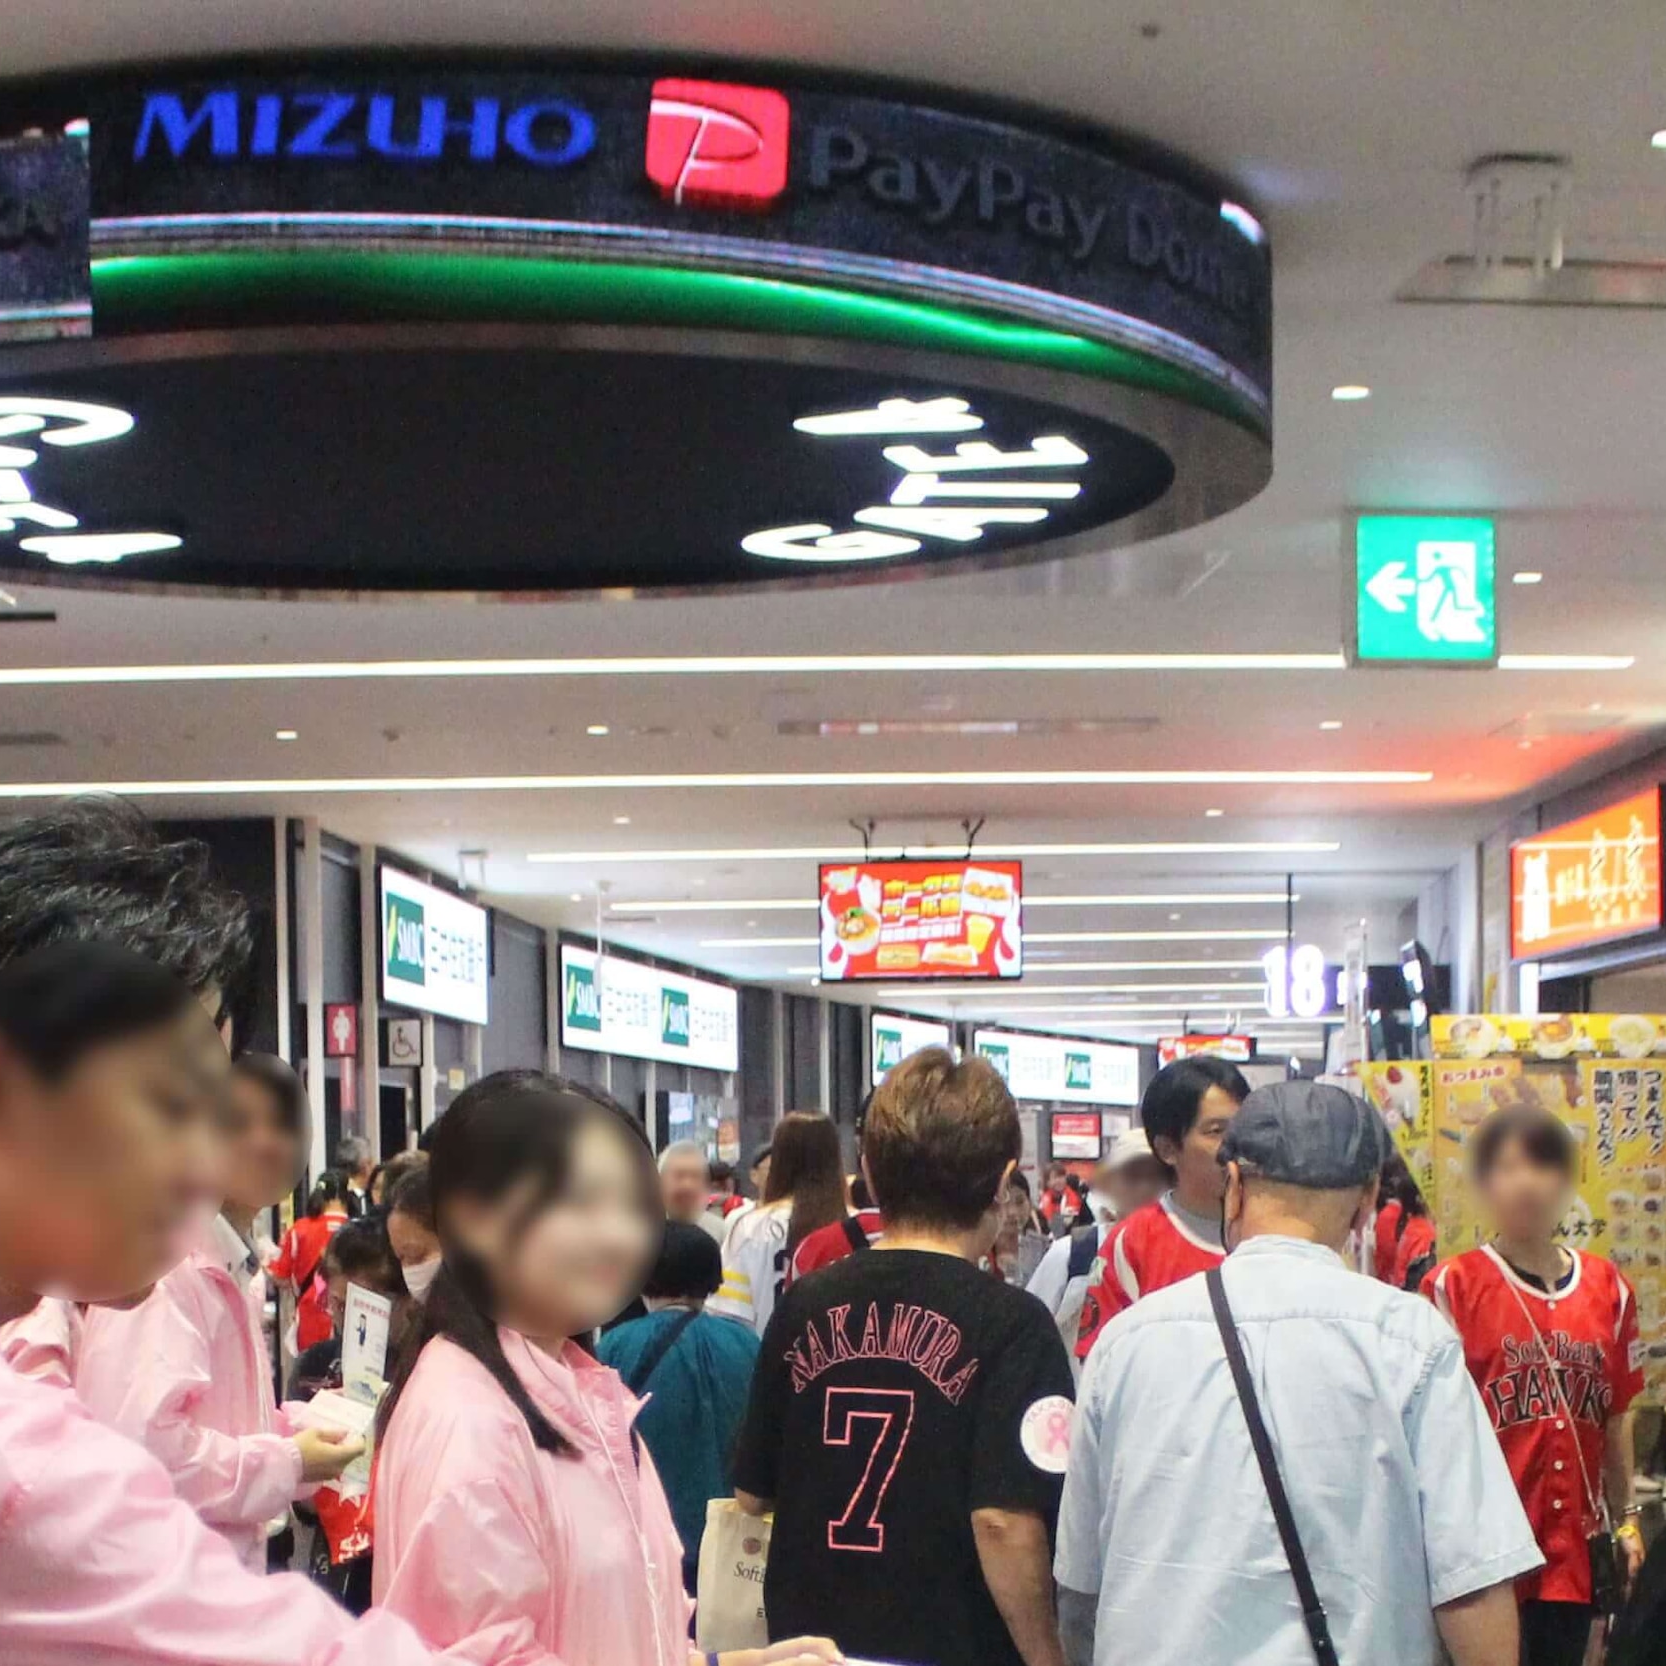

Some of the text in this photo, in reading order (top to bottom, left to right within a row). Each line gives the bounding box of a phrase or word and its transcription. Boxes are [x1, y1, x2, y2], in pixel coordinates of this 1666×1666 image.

[133, 91, 597, 166] MIZUHO
[810, 125, 1107, 260] PayPay
[741, 436, 1090, 563] GATE
[1262, 944, 1327, 1018] 18
[783, 1301, 980, 1407] NAKAMURA
[823, 1385, 915, 1552] 7
